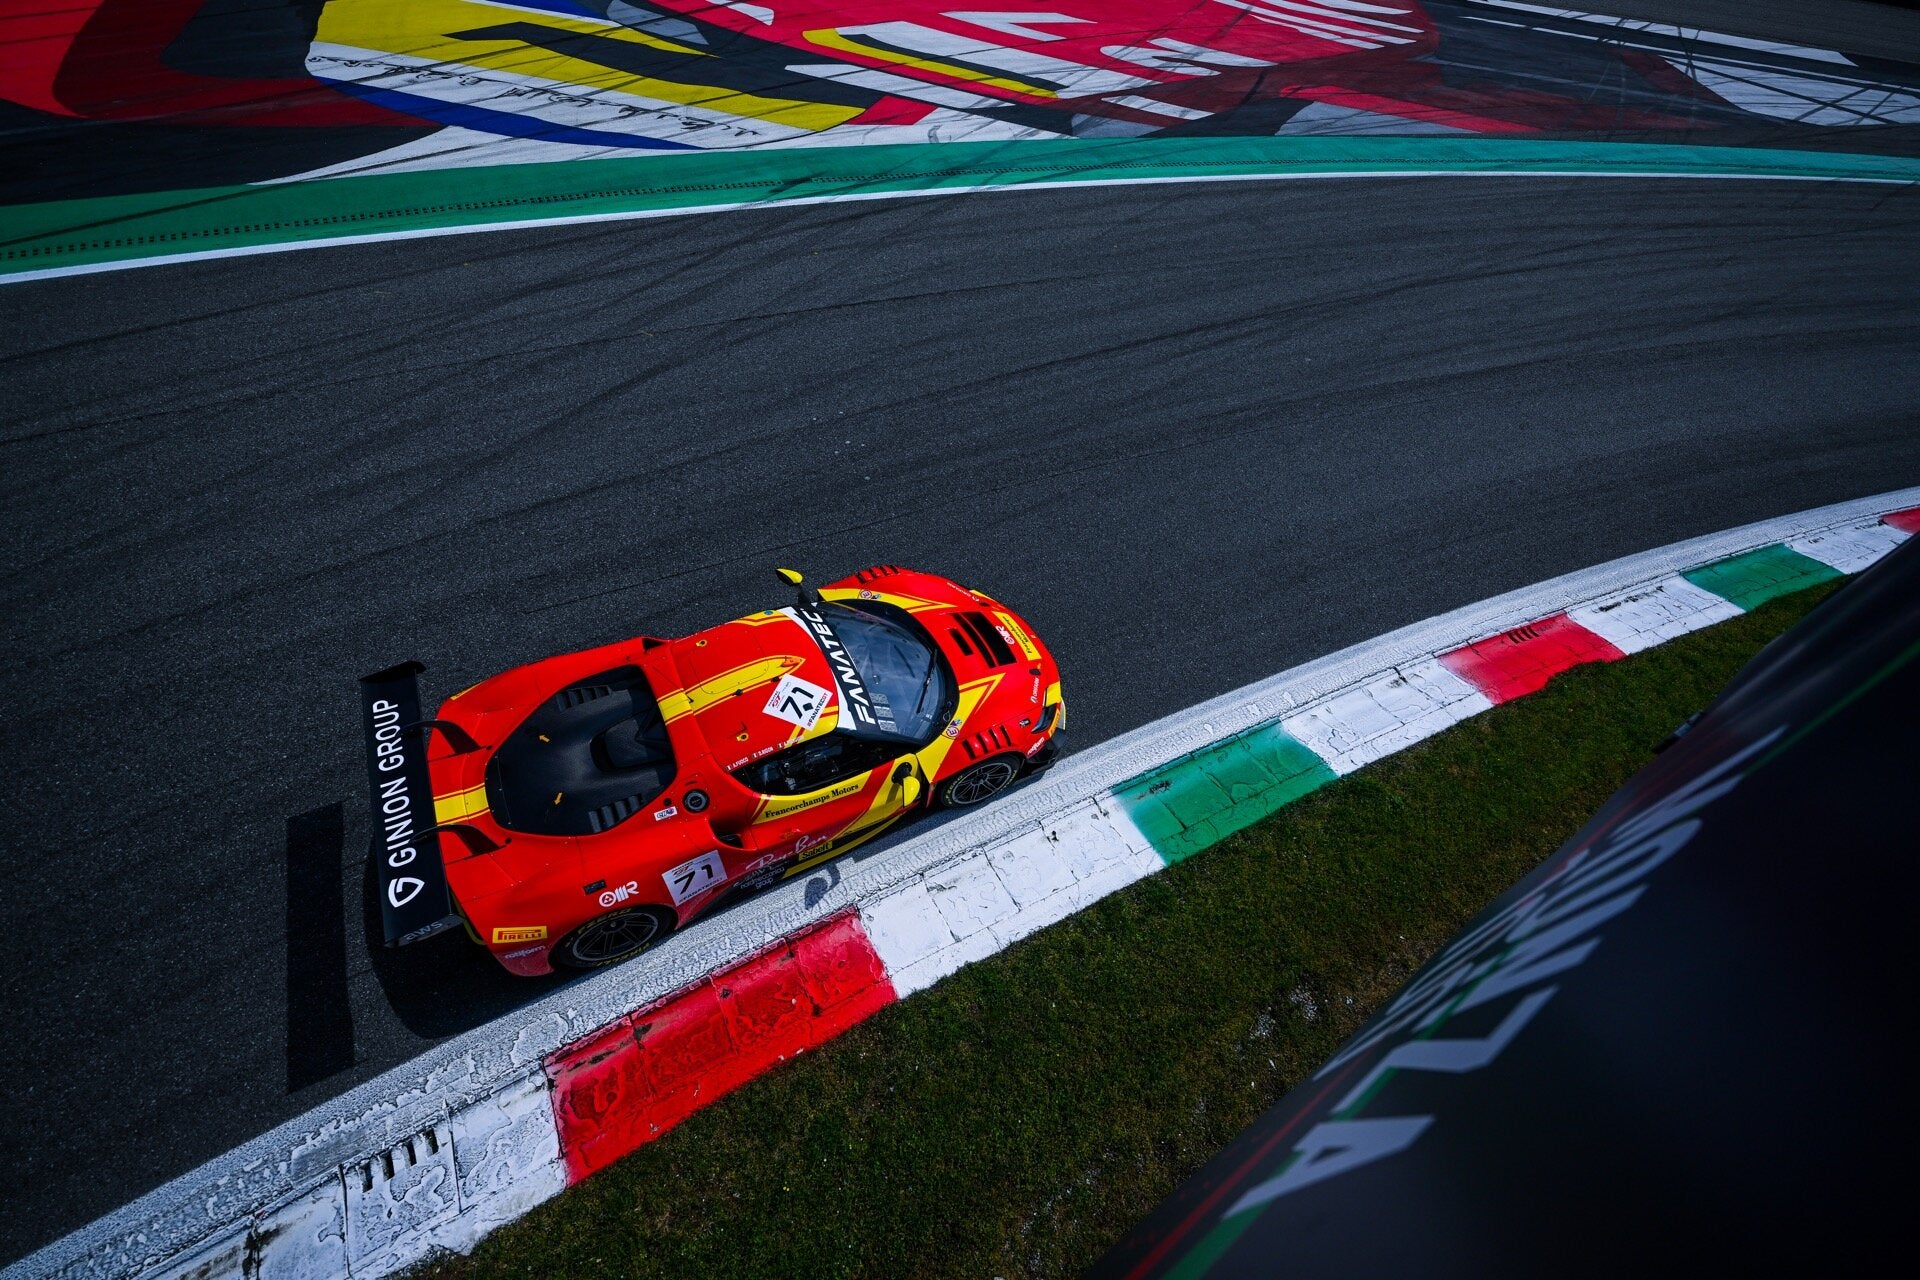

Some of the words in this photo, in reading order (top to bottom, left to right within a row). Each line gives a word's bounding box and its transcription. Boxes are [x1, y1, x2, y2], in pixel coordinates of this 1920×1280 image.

[800, 608, 876, 725] FANATEC
[779, 686, 815, 720] 71
[807, 692, 829, 728] #FANATECGT
[372, 700, 405, 772] GROUP
[765, 792, 831, 819] Francorchamps
[831, 783, 859, 798] Motors
[378, 776, 417, 868] GINION
[674, 864, 714, 895] 71
[755, 877, 774, 890] group
[404, 918, 443, 942] aws
[497, 929, 542, 942] PIRELLI
